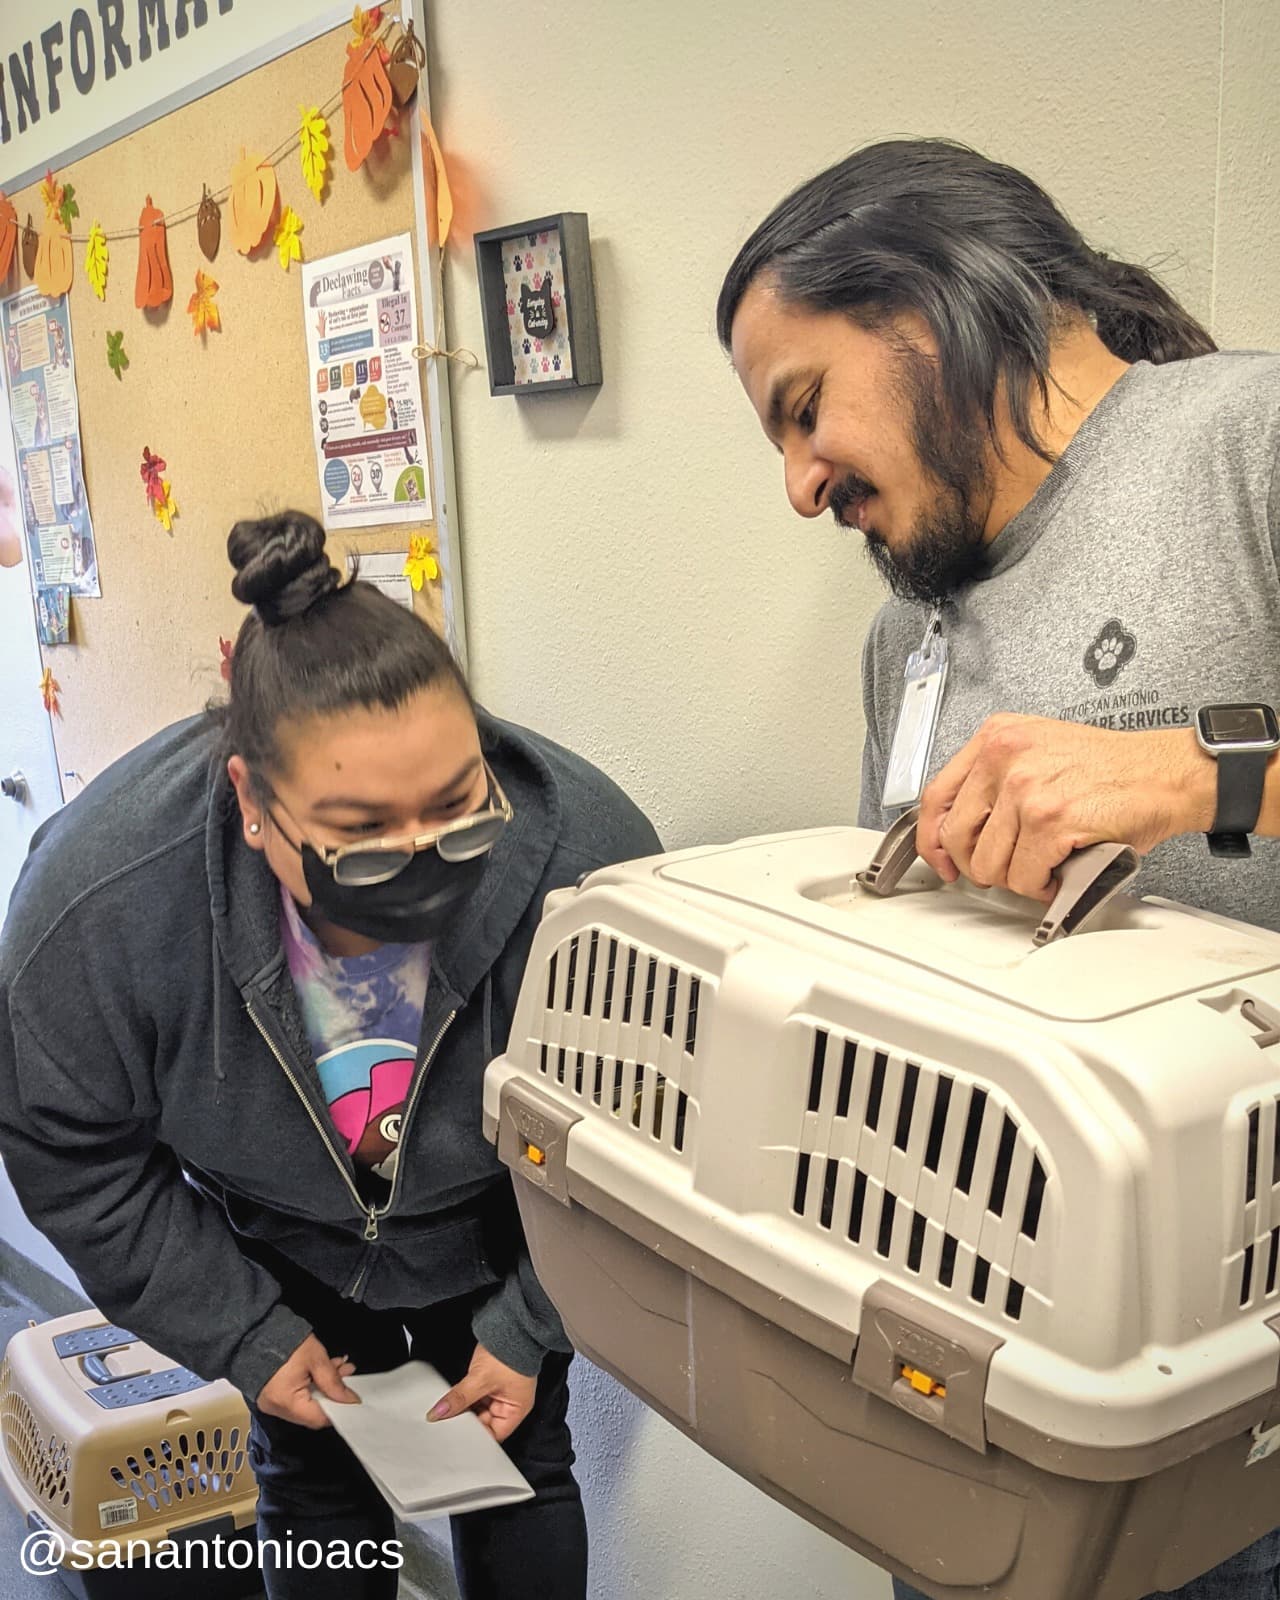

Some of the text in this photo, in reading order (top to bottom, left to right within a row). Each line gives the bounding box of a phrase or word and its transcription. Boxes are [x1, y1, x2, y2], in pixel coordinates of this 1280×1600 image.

[0, 0, 234, 145] INFORM
[322, 267, 368, 293] Declawing
[394, 309, 405, 325] 37
[1078, 700, 1089, 717] OF
[1090, 696, 1109, 714] SAN
[1112, 690, 1159, 709] ANTONIO
[1119, 705, 1190, 731] SERVICES
